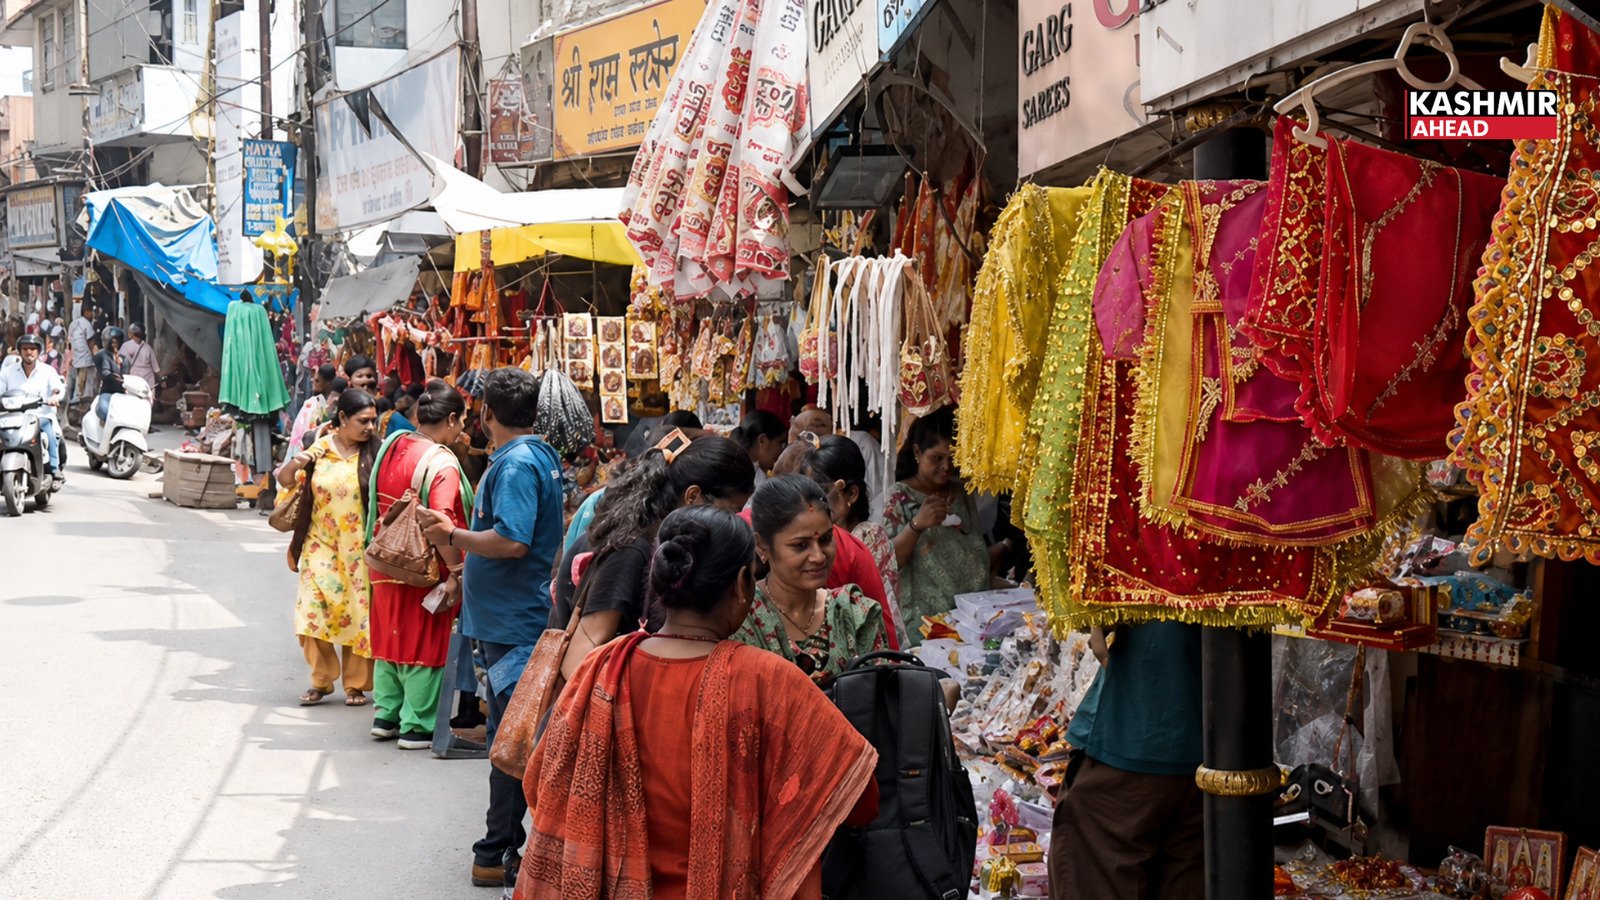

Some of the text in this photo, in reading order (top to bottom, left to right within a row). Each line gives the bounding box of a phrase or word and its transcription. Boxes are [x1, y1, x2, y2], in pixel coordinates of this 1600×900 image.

[1022, 3, 1073, 77] GARG
[562, 45, 582, 109] श्री
[1022, 76, 1071, 130] SAREES
